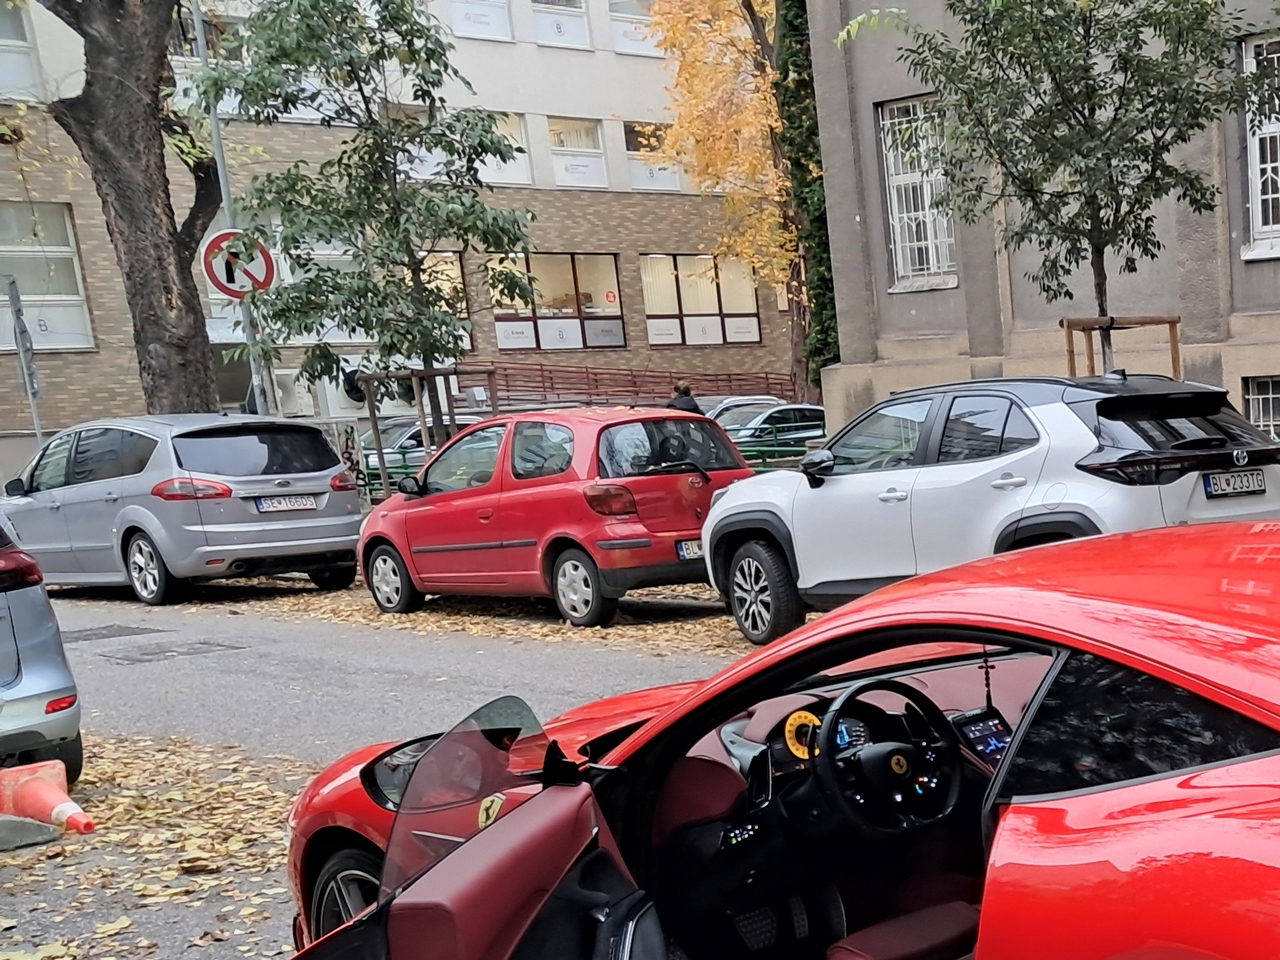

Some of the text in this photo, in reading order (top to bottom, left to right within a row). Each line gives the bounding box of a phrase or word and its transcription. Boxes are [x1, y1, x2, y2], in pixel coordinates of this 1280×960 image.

[1211, 472, 1264, 492] BL 233TG
[683, 543, 698, 556] BL
